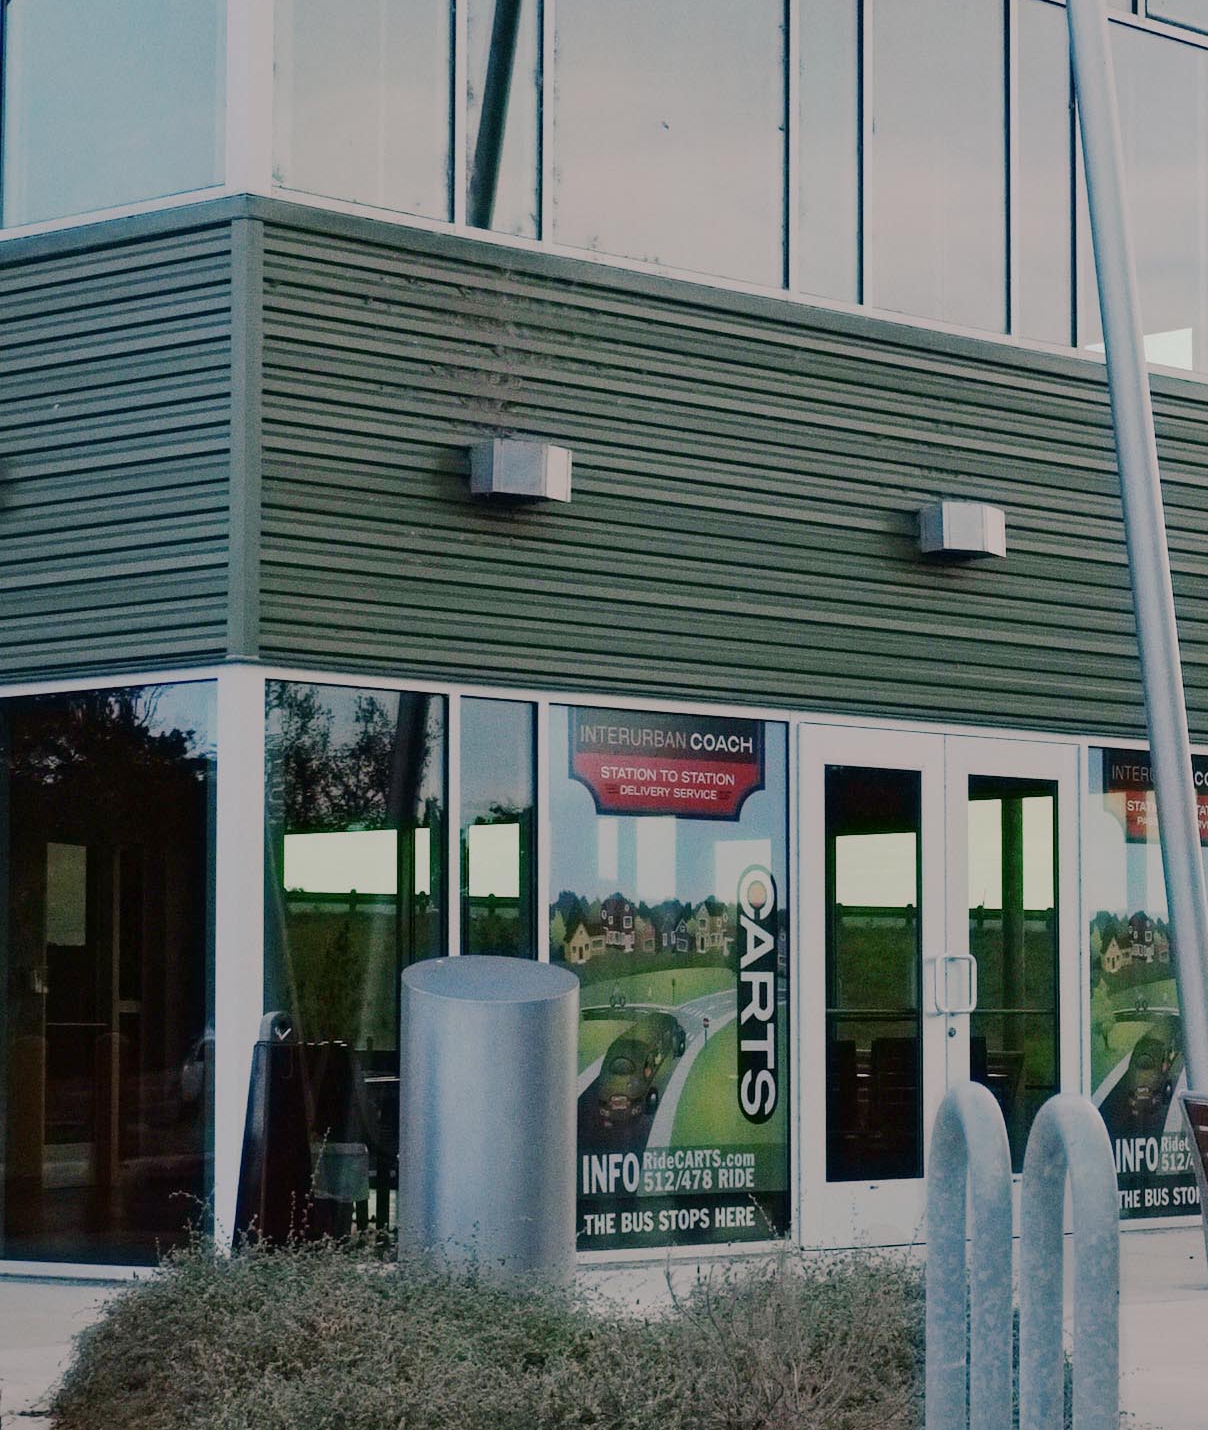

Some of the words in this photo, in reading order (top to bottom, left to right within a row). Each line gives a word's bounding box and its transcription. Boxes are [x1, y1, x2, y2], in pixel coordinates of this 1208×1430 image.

[580, 724, 686, 749] INTERURBAN
[690, 733, 753, 753] COACH
[601, 766, 656, 782] STATION
[660, 769, 679, 783] TO
[681, 771, 736, 786] STATION
[1112, 764, 1153, 783] INTER
[620, 784, 670, 797] DELIVERY
[674, 788, 717, 800] SERVICE
[740, 871, 776, 1118] CARTS
[643, 1149, 755, 1170] RideCARTS.com
[1115, 1136, 1159, 1173] INFO
[582, 1152, 640, 1194] INFO
[644, 1170, 713, 1192] 512/478
[718, 1168, 755, 1189] RIDE
[1119, 1189, 1141, 1208] THE
[1145, 1187, 1170, 1207] BUS
[584, 1213, 616, 1235] THE
[621, 1210, 654, 1233] BUS
[658, 1207, 710, 1231] STOPS
[715, 1206, 756, 1228] HERE
